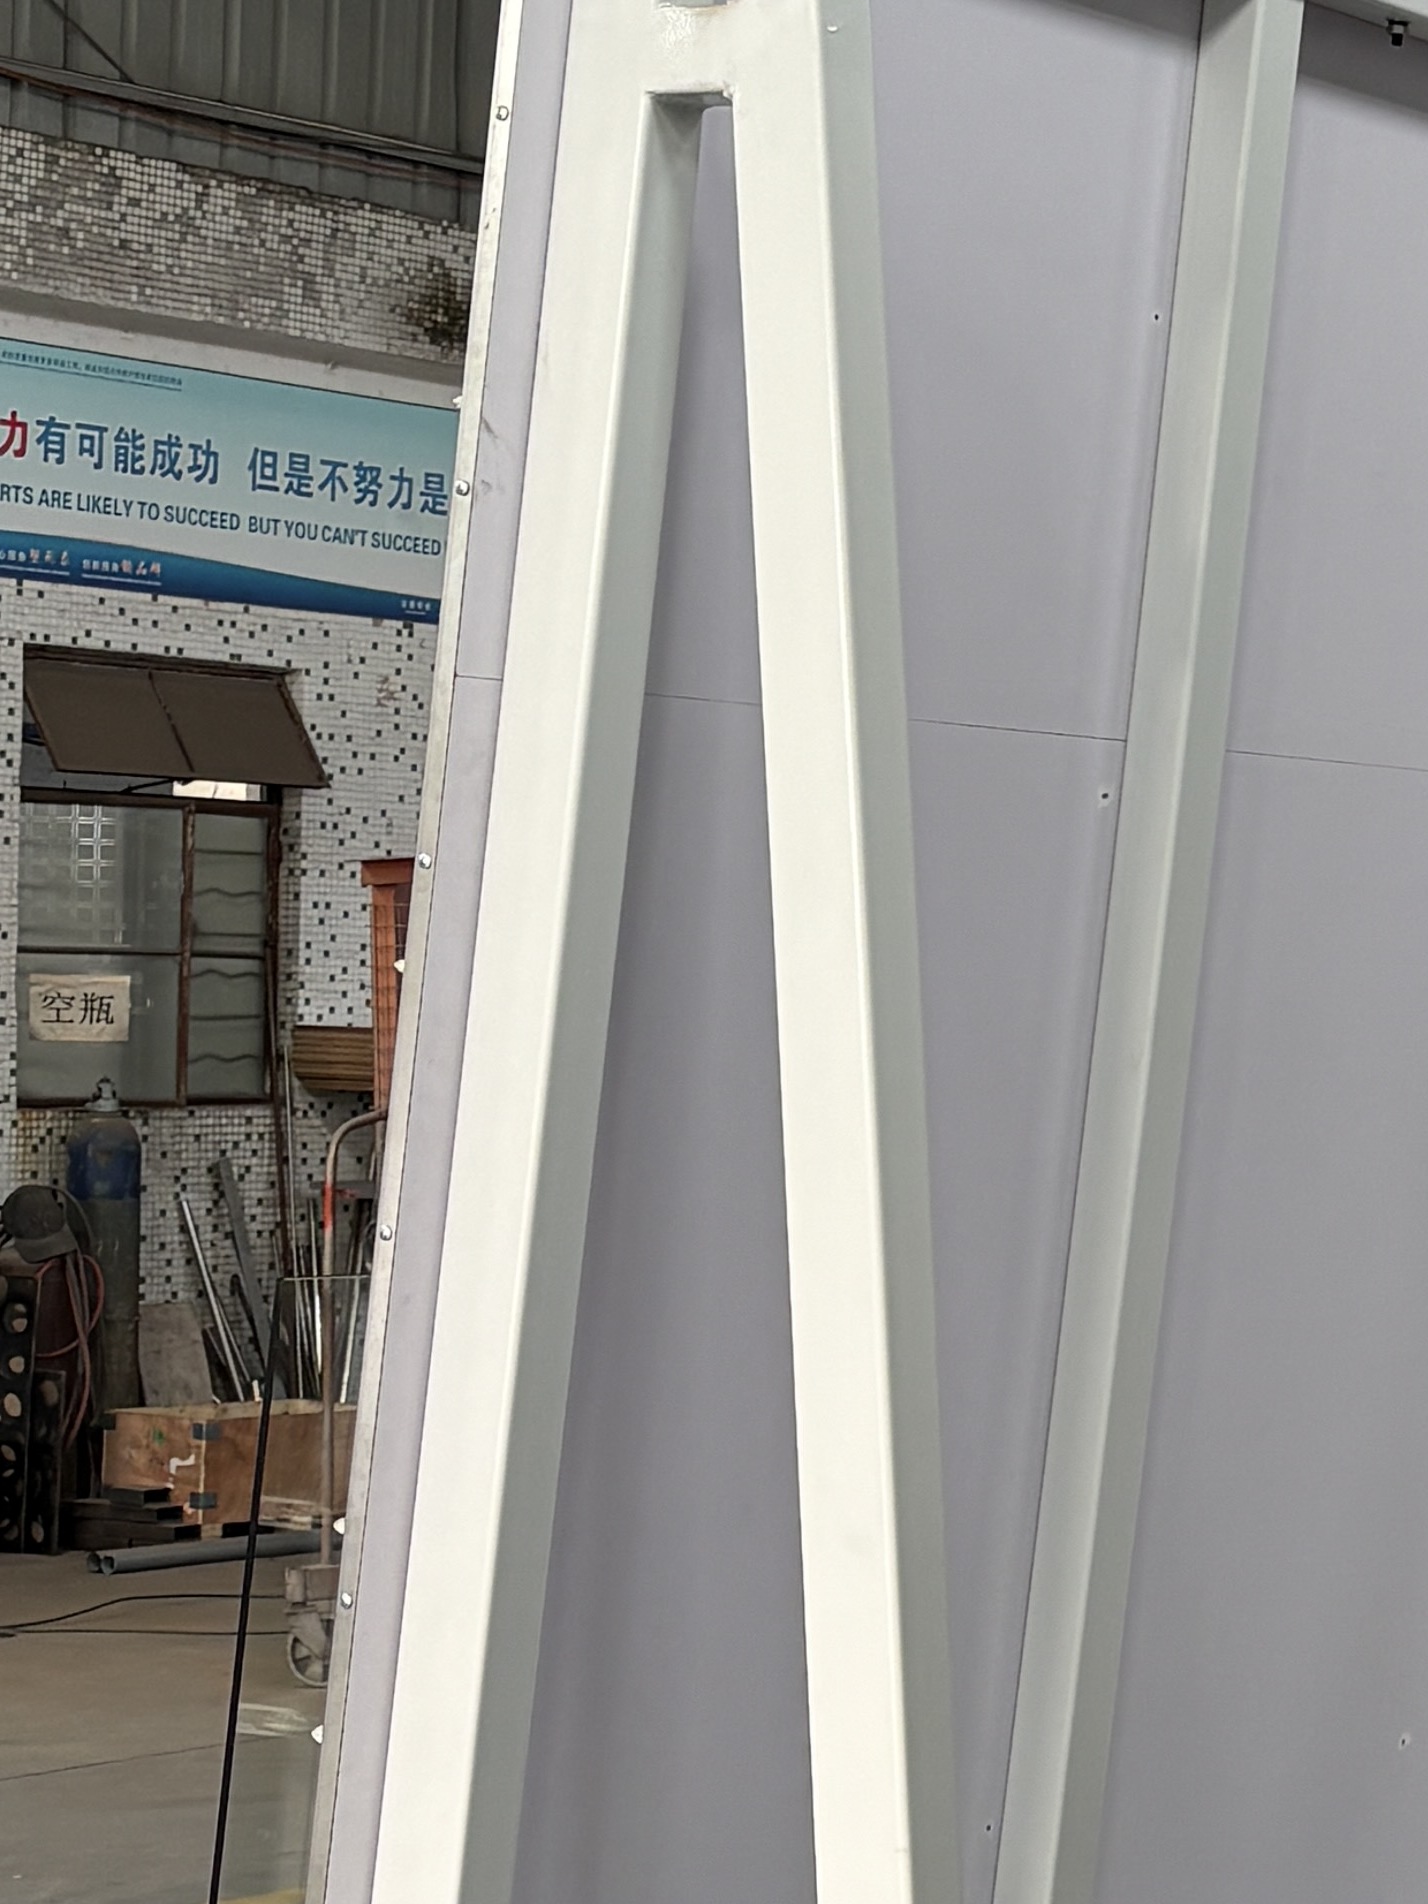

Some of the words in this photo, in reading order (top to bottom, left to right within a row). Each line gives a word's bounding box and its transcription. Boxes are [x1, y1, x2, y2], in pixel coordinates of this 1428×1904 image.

[0, 410, 220, 486] 力有可能成功
[247, 446, 448, 516] 但是不努力是
[0, 483, 33, 505] RTS
[38, 489, 73, 510] ARE
[77, 493, 134, 518] LIKELY
[138, 501, 160, 521] TO
[163, 505, 240, 531] SUCCEED
[248, 516, 281, 537] BUT
[284, 520, 318, 541] YOU
[321, 525, 368, 546] CAN'T
[371, 531, 441, 556] SUCCEED
[41, 989, 115, 1025] 空瓶
